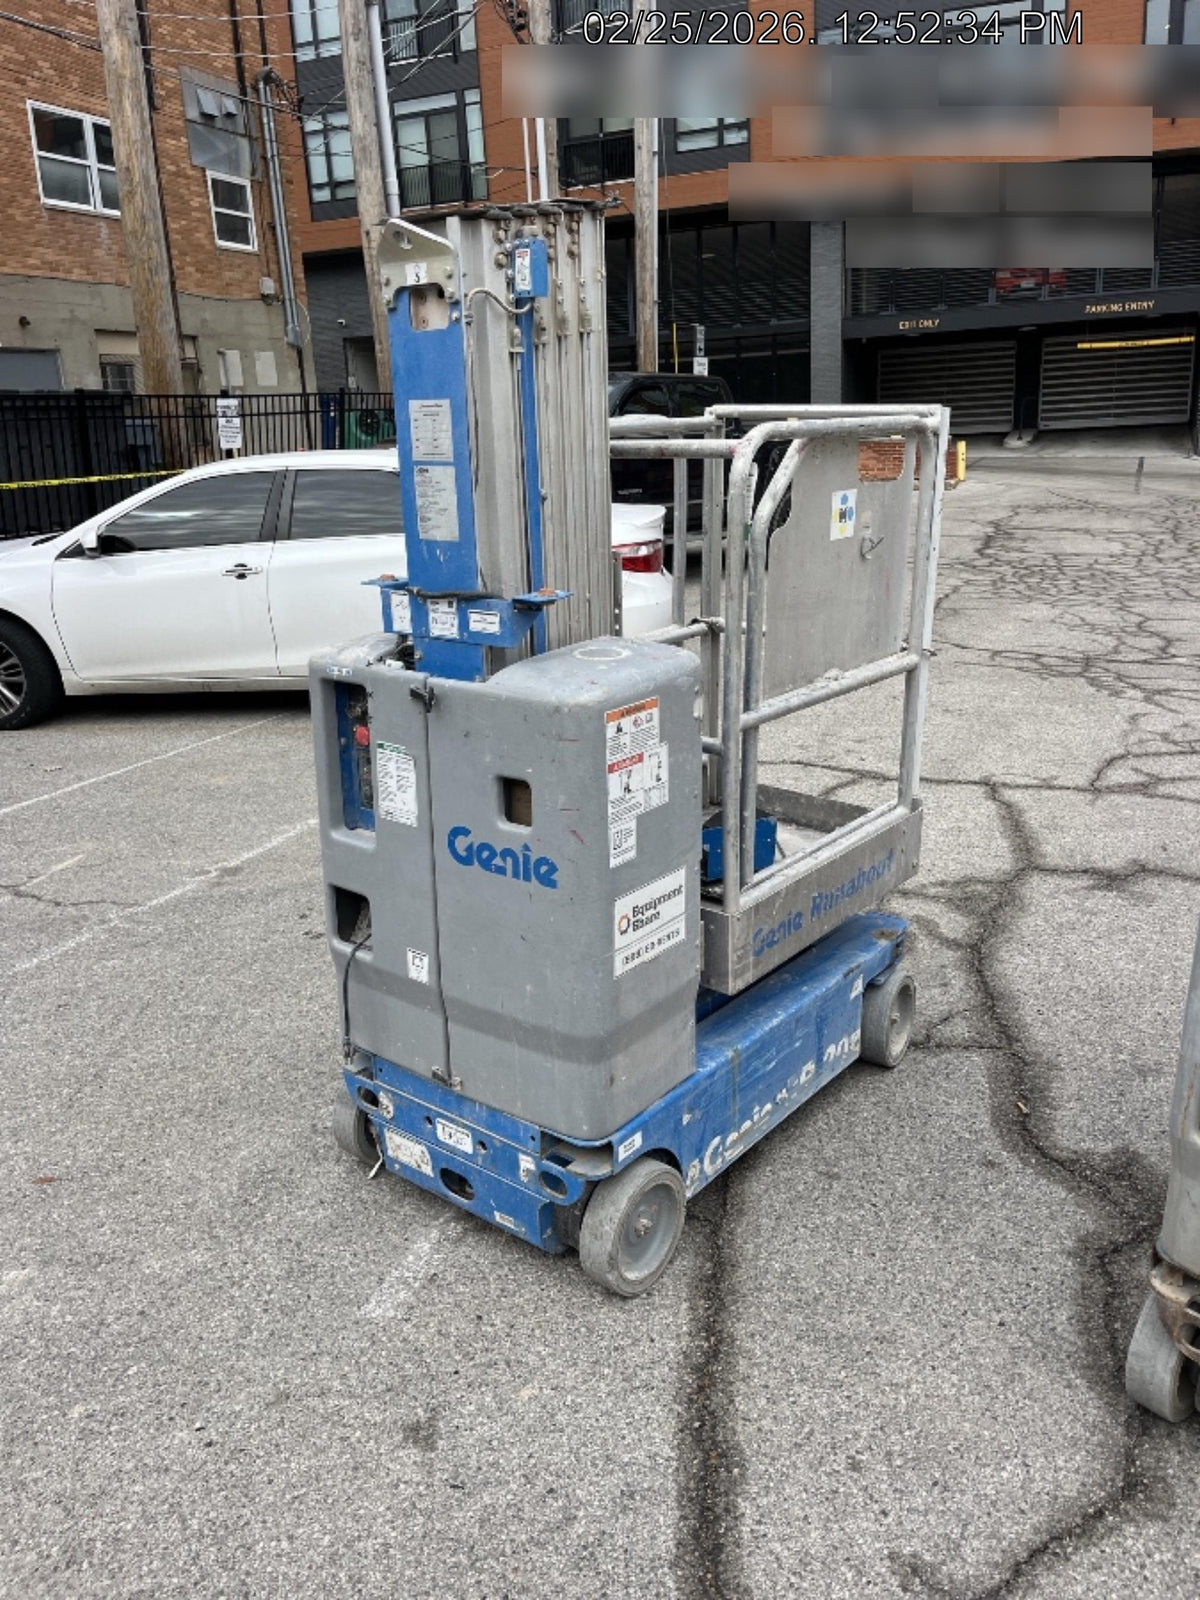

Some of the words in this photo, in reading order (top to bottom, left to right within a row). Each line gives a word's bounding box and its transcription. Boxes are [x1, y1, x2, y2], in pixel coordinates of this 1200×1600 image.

[1125, 300, 1155, 311] ENTRY
[447, 825, 559, 890] Genie
[631, 884, 684, 918] Equipment
[752, 909, 805, 958] Genie
[810, 849, 894, 921] Runabout
